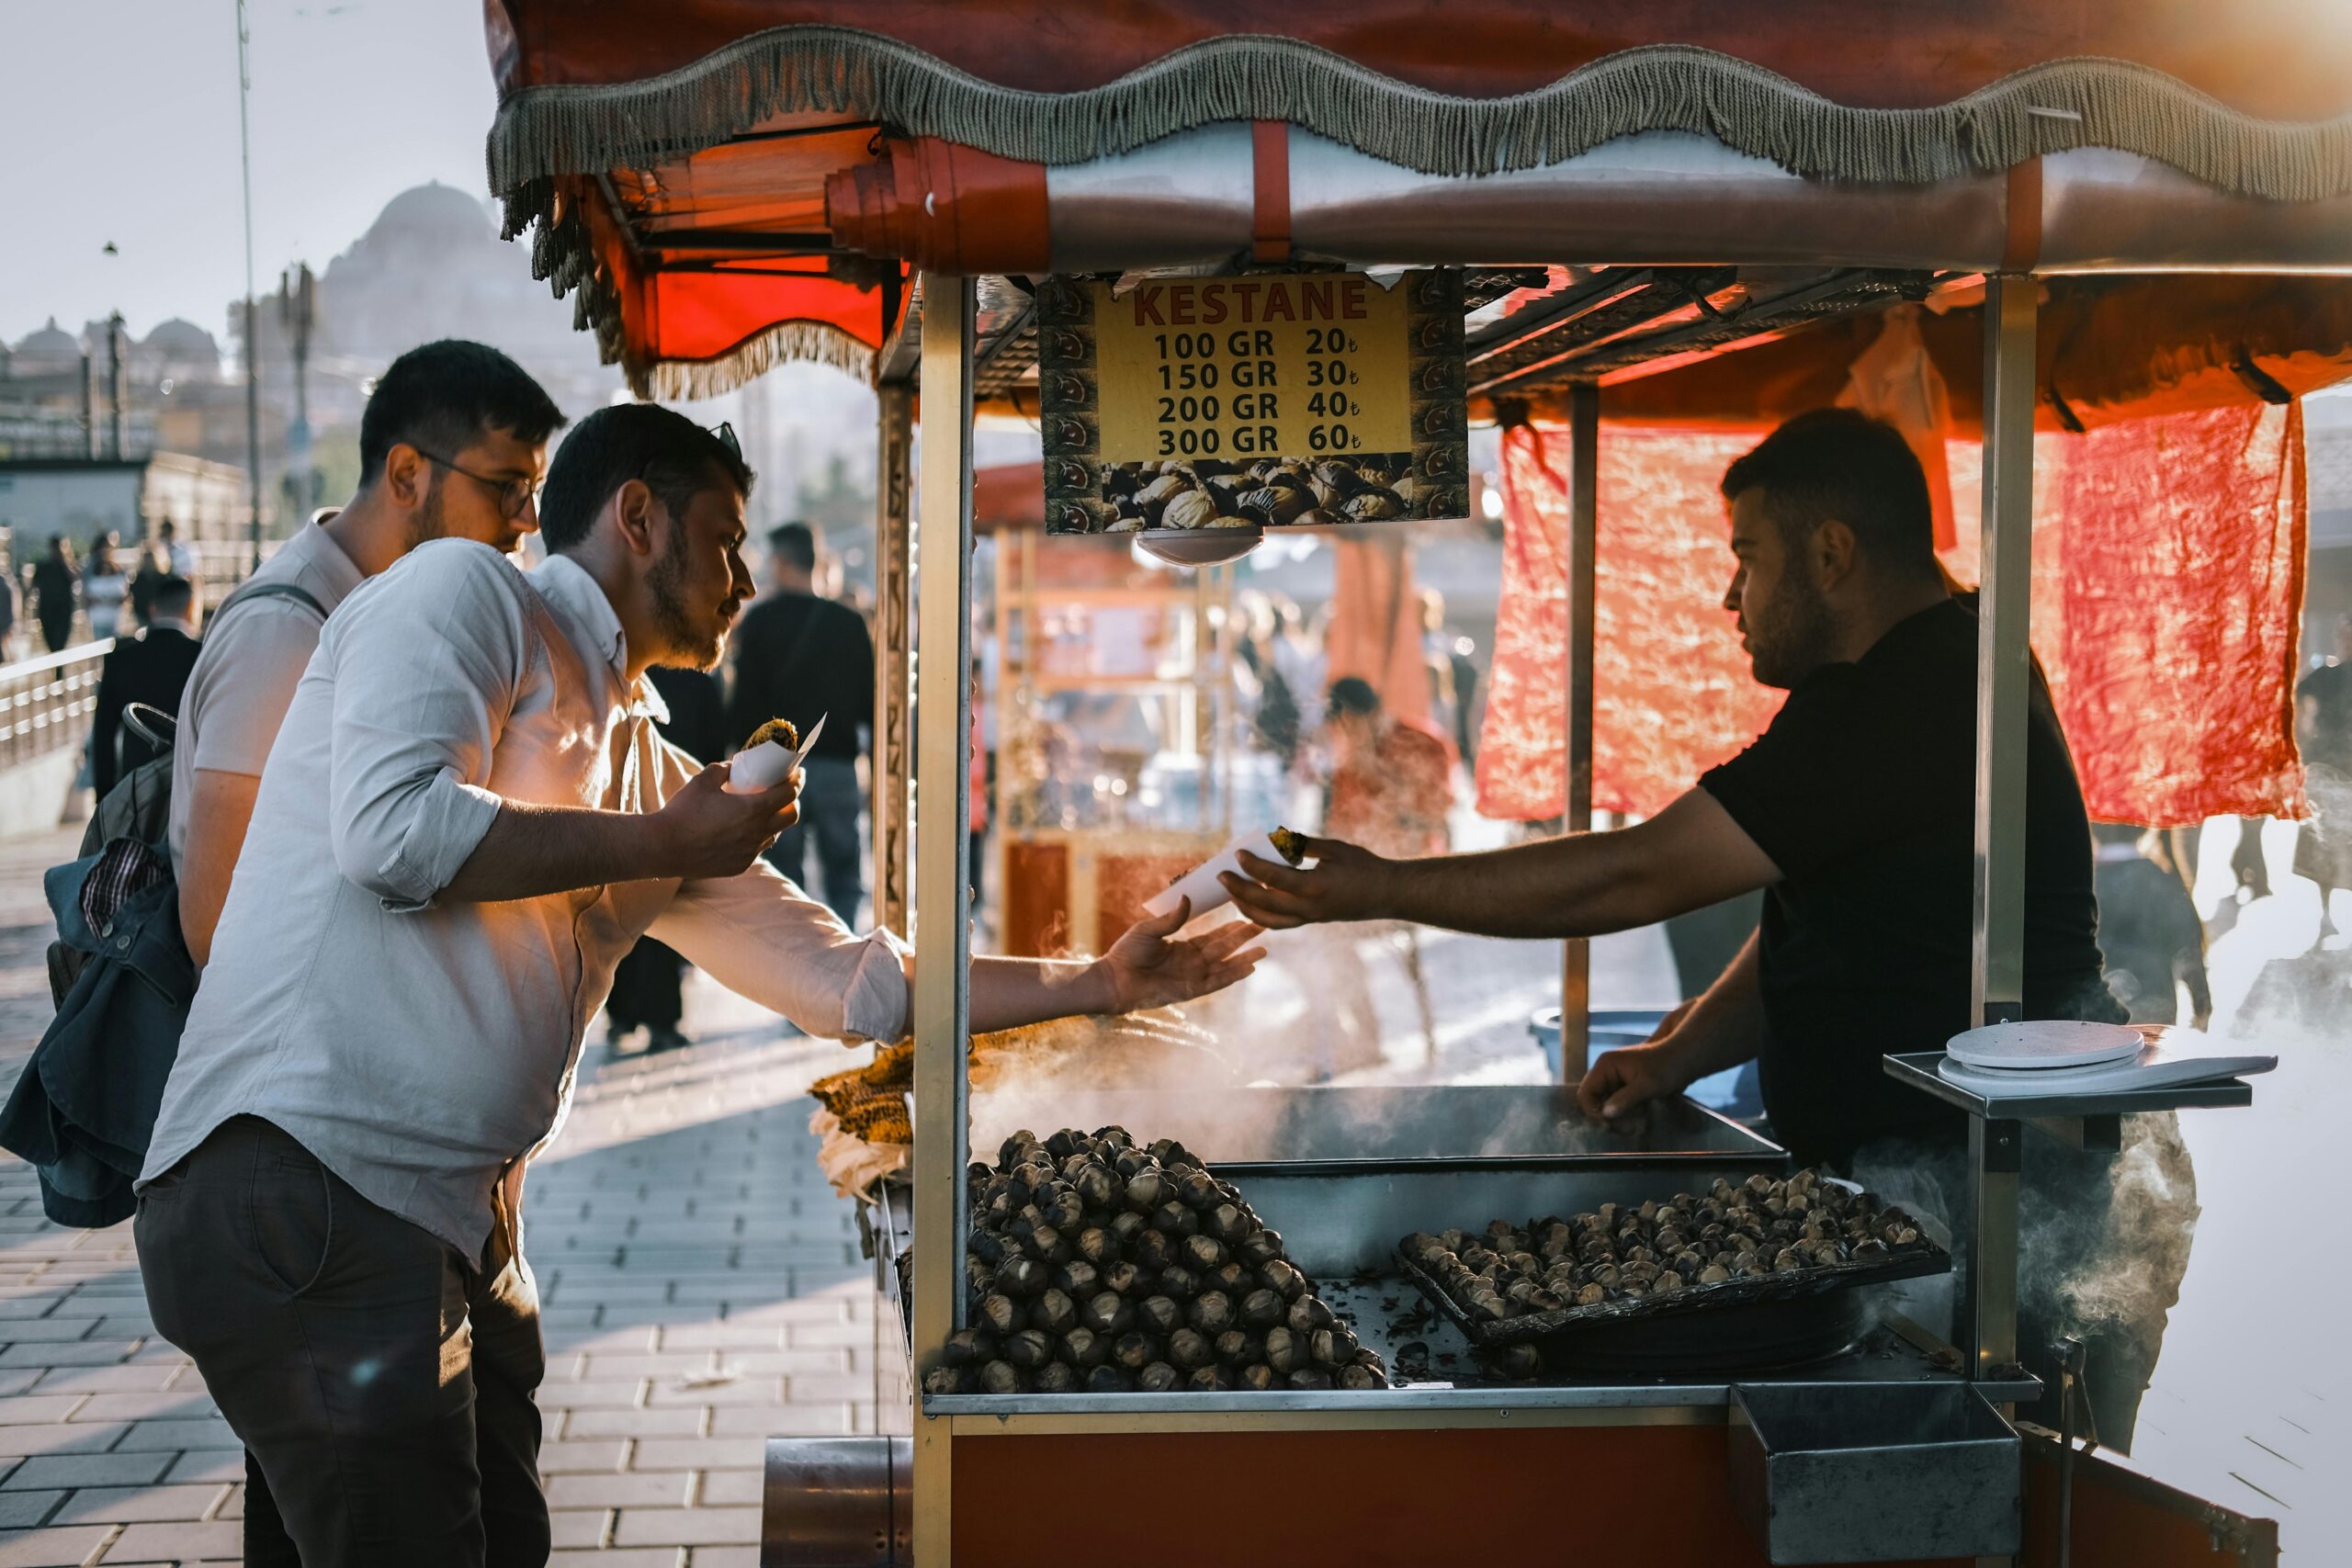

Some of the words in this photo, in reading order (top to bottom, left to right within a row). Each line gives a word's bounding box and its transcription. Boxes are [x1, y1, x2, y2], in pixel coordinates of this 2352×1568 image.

[1134, 280, 1367, 326] KESTANE
[1155, 333, 1215, 360] 100
[1227, 330, 1274, 356] GR
[1158, 364, 1219, 390] 150
[1231, 362, 1278, 389] GR
[1159, 396, 1220, 423] 200
[1232, 394, 1279, 421] GR
[1159, 429, 1220, 457] 300
[1232, 426, 1279, 453] GR
